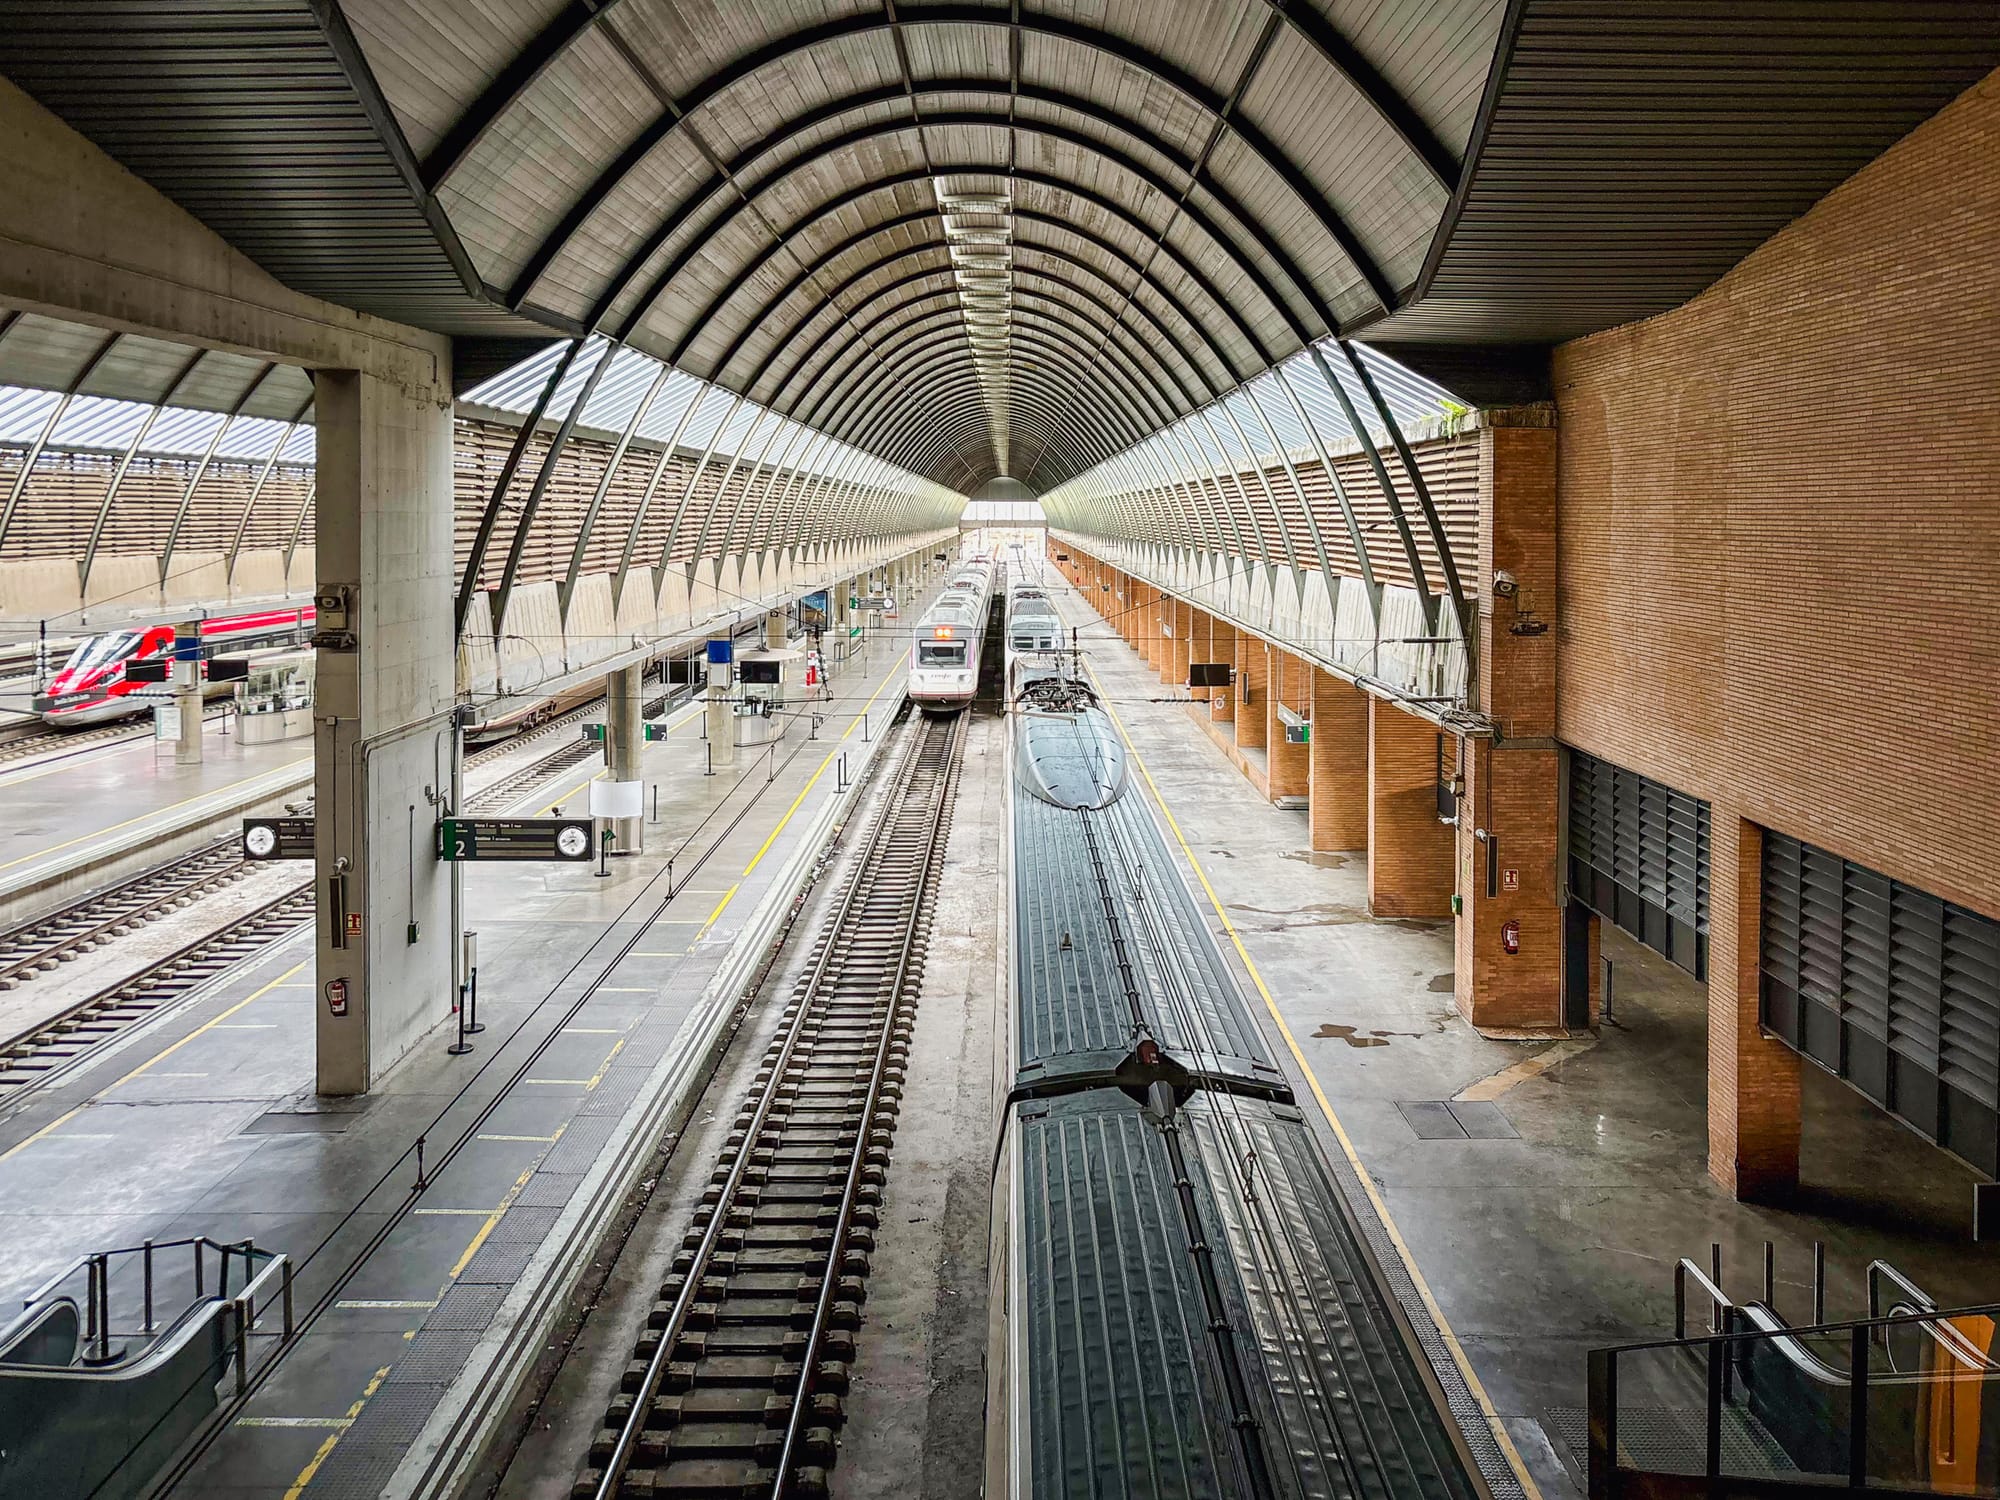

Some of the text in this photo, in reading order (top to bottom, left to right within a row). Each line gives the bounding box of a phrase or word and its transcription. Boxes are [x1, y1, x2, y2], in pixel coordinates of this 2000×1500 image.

[583, 732, 589, 740] 3
[1287, 733, 1293, 742] 1
[455, 840, 466, 857] 2
